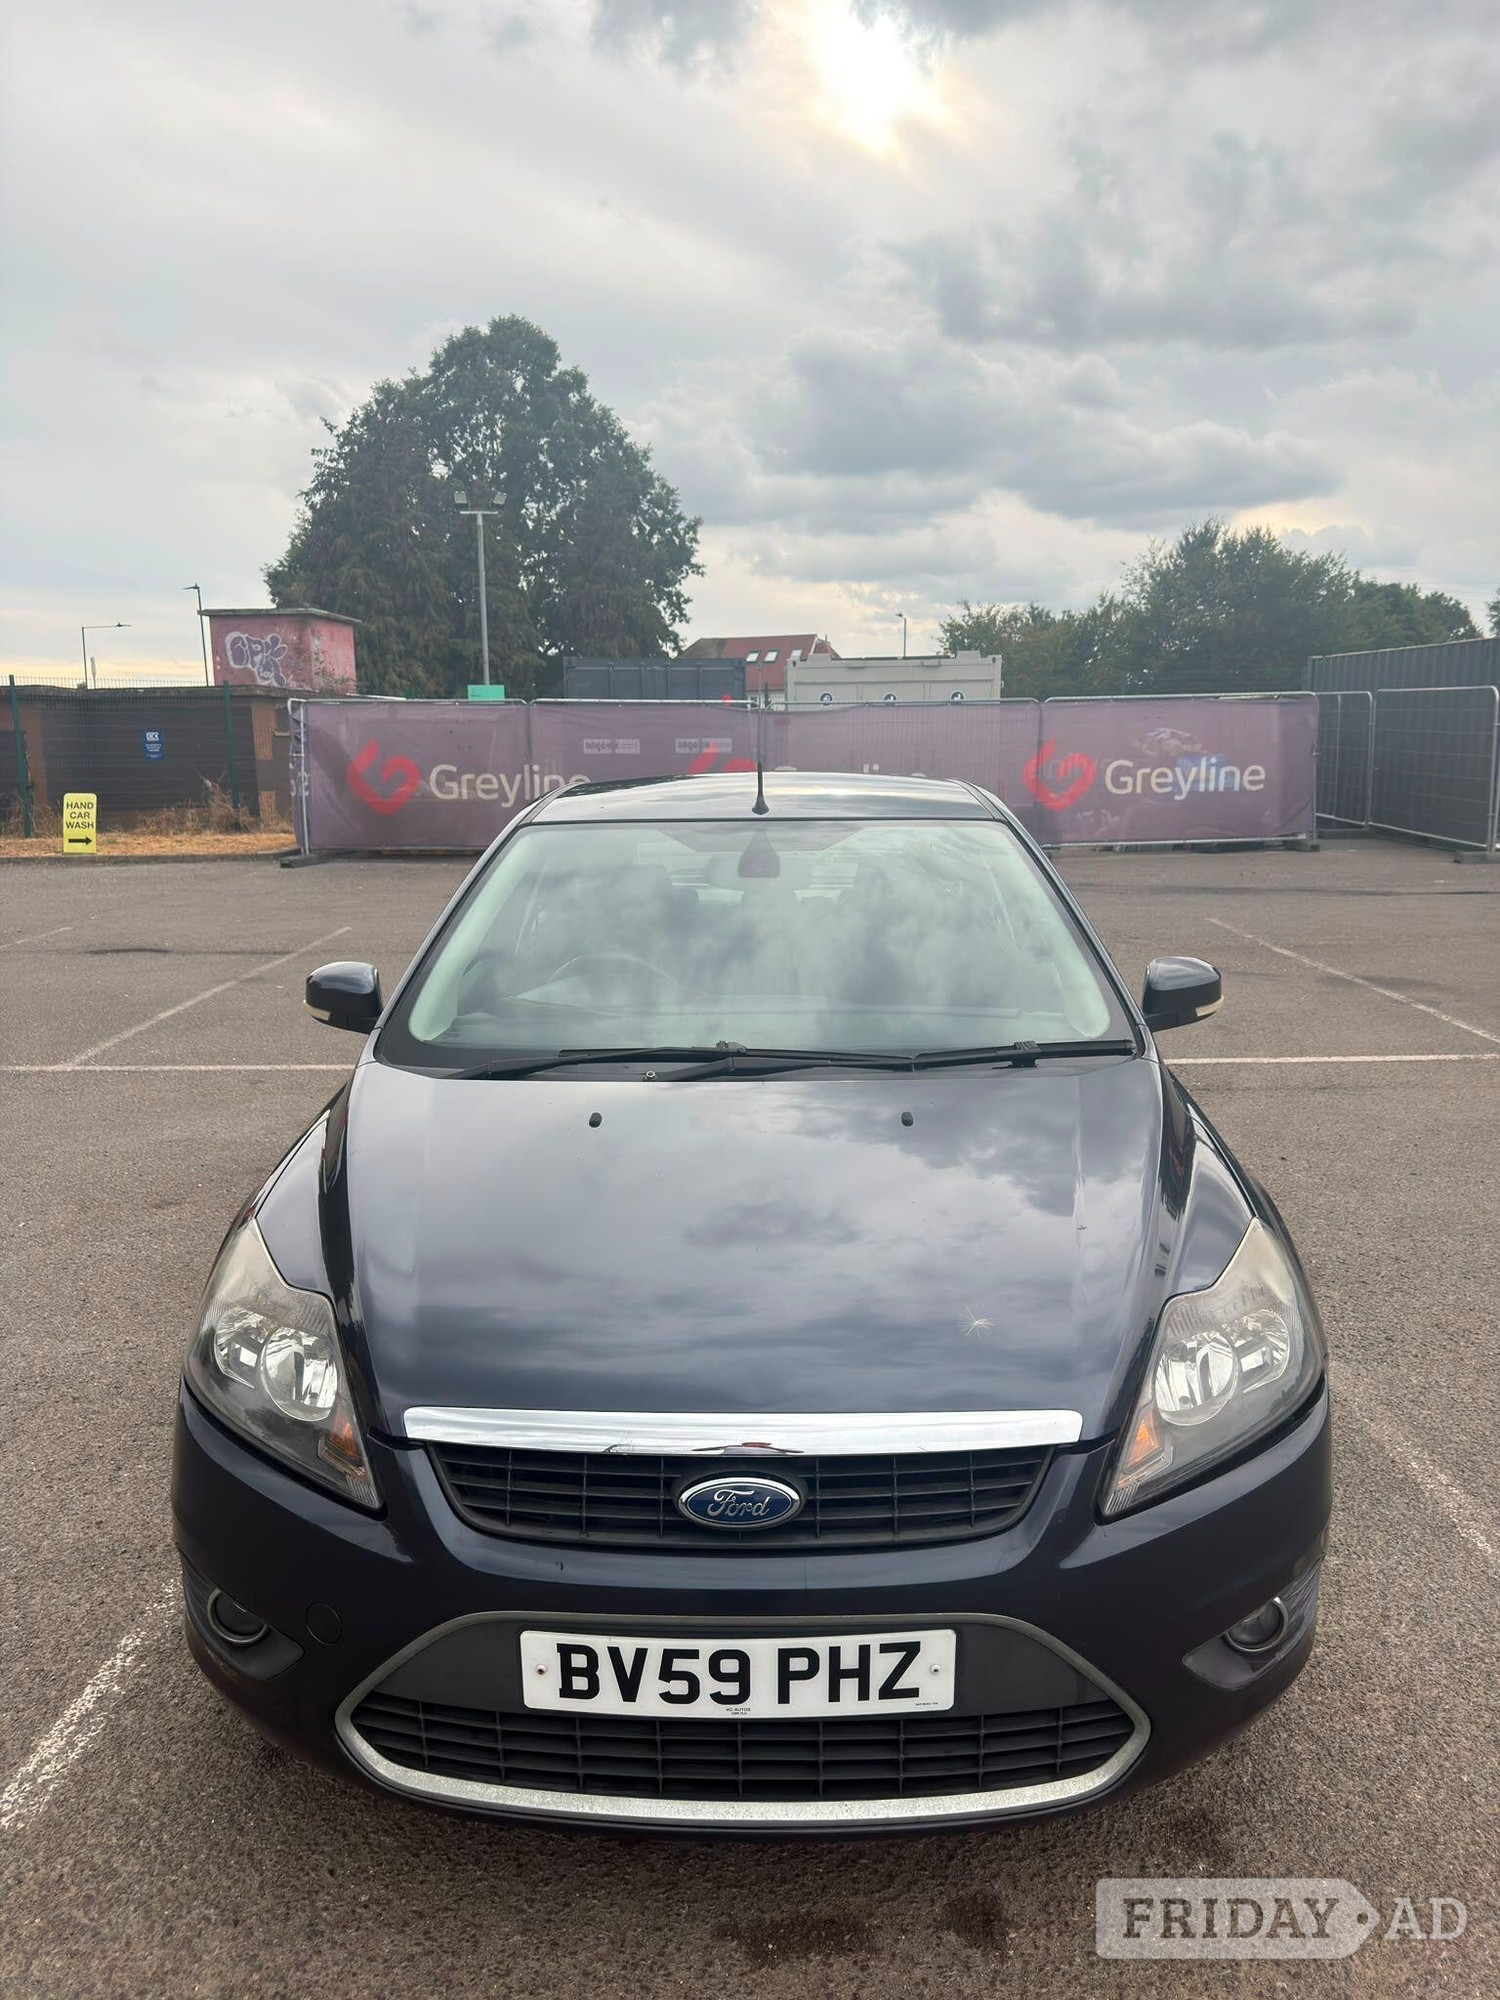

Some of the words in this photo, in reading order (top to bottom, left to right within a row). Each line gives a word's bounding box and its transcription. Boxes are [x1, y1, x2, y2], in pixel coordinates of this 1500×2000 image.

[1105, 756, 1266, 801] Greyline
[66, 802, 94, 810] HAND
[70, 811, 90, 819] CAR
[65, 821, 94, 829] WASH
[707, 1489, 771, 1517] Ford
[556, 1642, 751, 1705] BV59
[777, 1640, 922, 1705] PHZ
